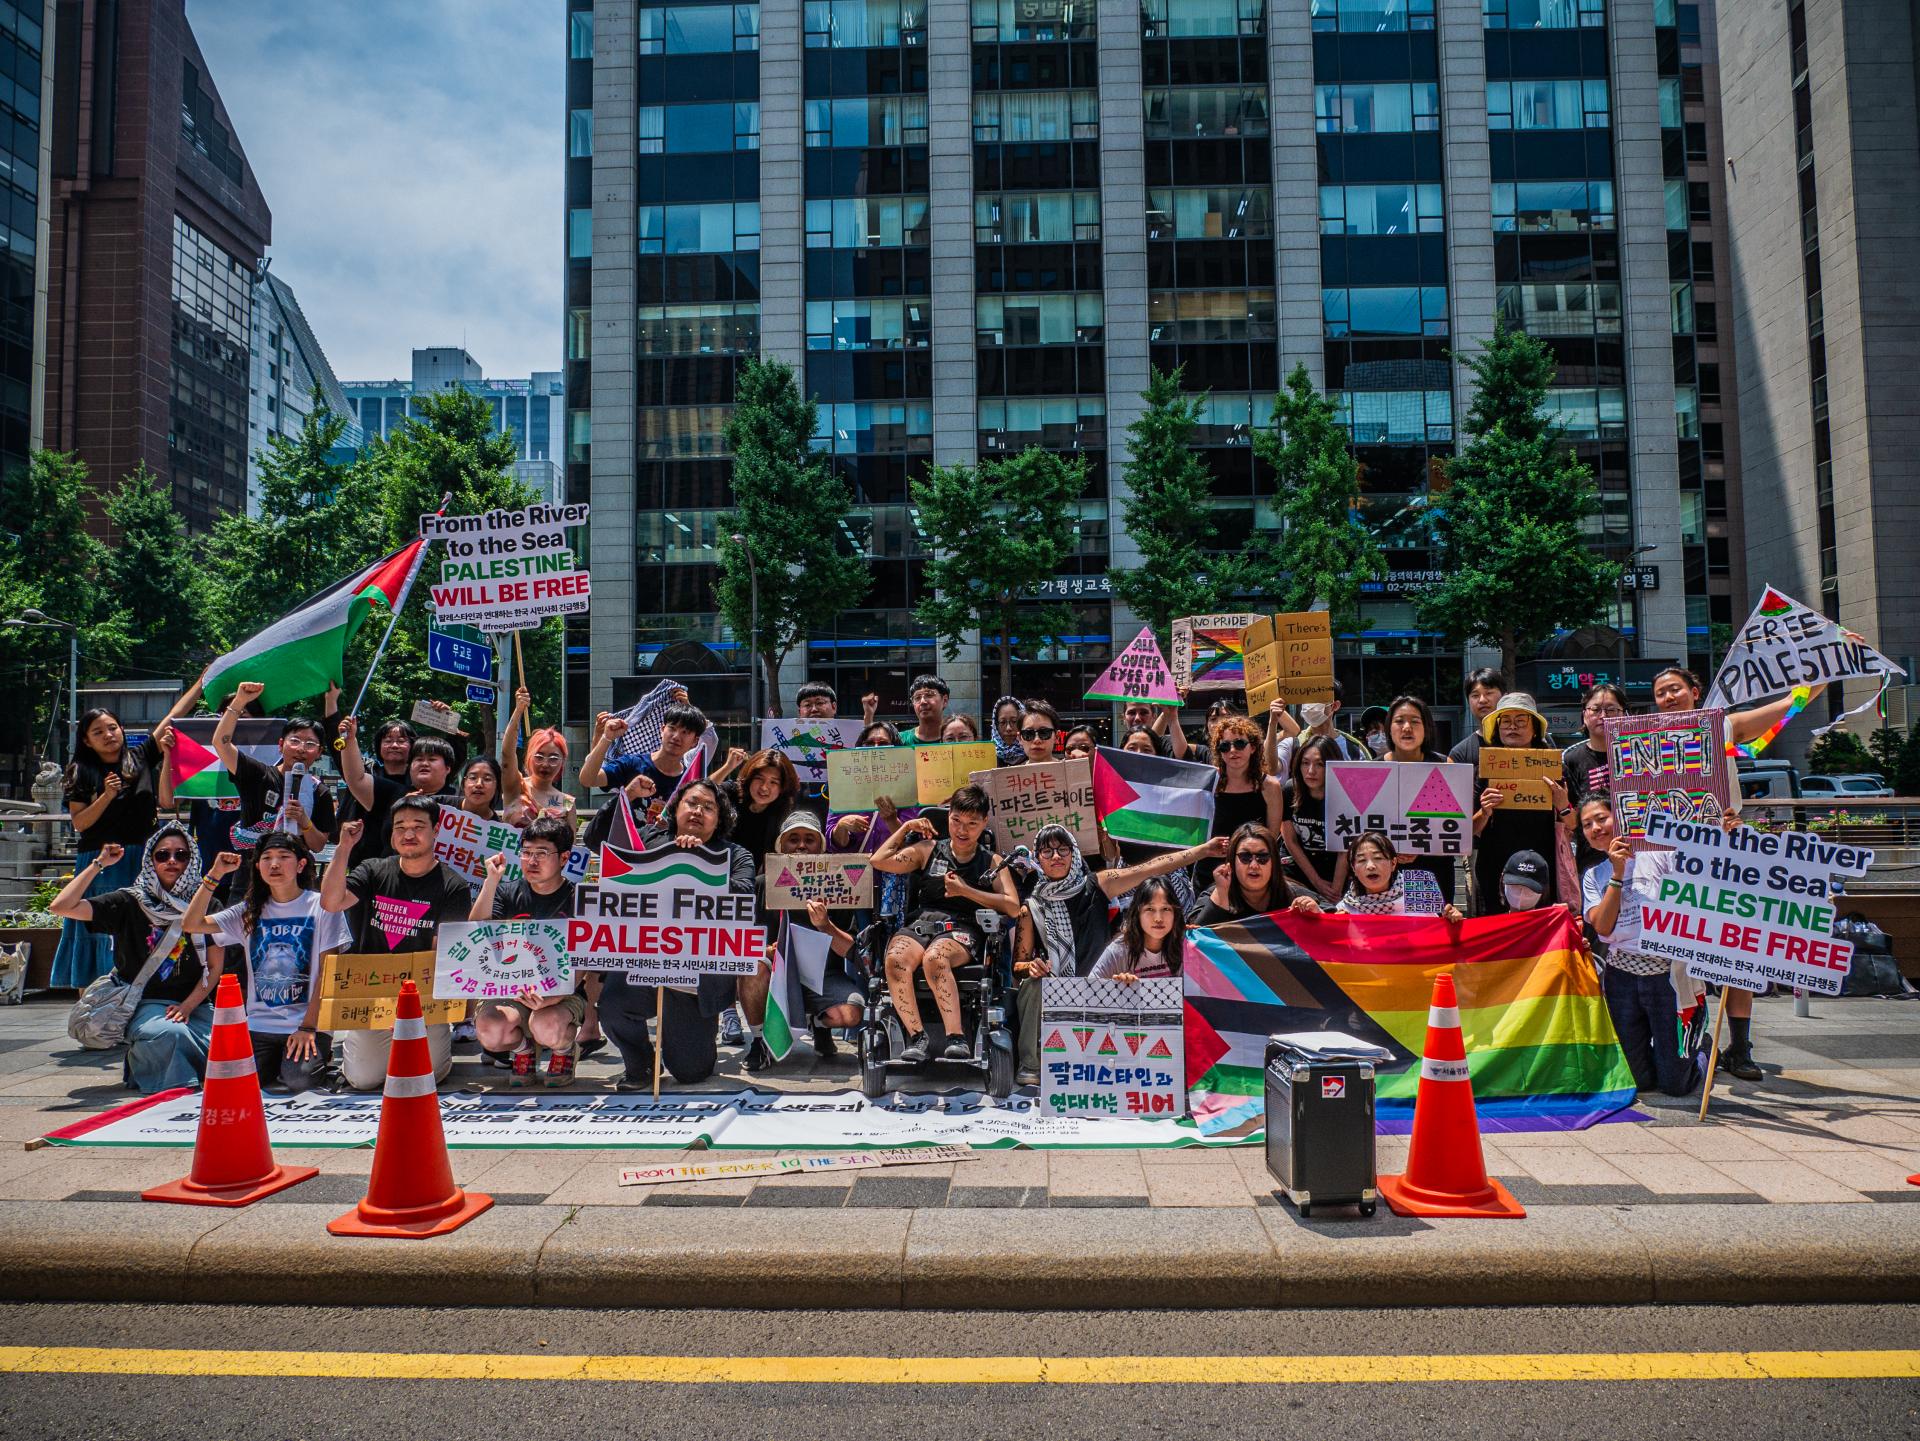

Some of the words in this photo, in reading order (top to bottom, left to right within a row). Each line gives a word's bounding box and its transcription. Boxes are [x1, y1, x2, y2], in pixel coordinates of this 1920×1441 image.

[421, 515, 482, 535] From
[486, 509, 525, 530] the
[530, 504, 588, 526] River
[450, 540, 473, 557] to
[478, 536, 517, 554] the
[521, 532, 564, 549] Sea
[443, 552, 572, 582] PALESTINE
[433, 586, 494, 607] WILL
[499, 583, 529, 602] BE
[534, 574, 590, 599] FREE
[438, 609, 483, 623] 팔레스타인과
[483, 607, 514, 620] 연대하는
[514, 606, 529, 618] 한국
[529, 603, 558, 616] 시민사회
[558, 600, 587, 613] 긴급행동
[1194, 618, 1209, 626] NO
[1213, 616, 1248, 626] PRIDE
[482, 619, 538, 631] #freepalestine
[1285, 622, 1327, 634] There's
[1745, 612, 1823, 654] FREE
[1132, 639, 1154, 653] ALL
[1121, 654, 1160, 670] QUEER
[1292, 655, 1327, 668] Pride
[1717, 641, 1881, 705] PALESTINE
[1109, 667, 1143, 683] EYES
[1146, 671, 1165, 688] ON
[1123, 683, 1150, 697] YOU
[1488, 754, 1519, 770] 우리는
[1006, 772, 1056, 792] 퀴어는
[1513, 793, 1547, 803] exist
[437, 808, 483, 843] 어는
[1648, 814, 1721, 847] From
[1728, 828, 1779, 856] the
[1785, 836, 1872, 871] River
[796, 861, 830, 875] 우리의
[1674, 850, 1703, 875] to
[1711, 857, 1760, 886] the
[1767, 865, 1826, 898] Sea
[576, 885, 659, 918] FREE
[672, 887, 754, 921] FREE
[1659, 878, 1833, 934] PALESTINE
[567, 920, 765, 958] PALESTINE
[1642, 906, 1714, 945] WILL
[1719, 922, 1762, 953] BE
[1766, 932, 1851, 972] FREE
[570, 956, 624, 969] 팔레스타인과
[625, 958, 661, 970] 연대하는
[662, 959, 680, 970] 한국
[682, 959, 718, 972] 시민사회
[719, 961, 755, 972] 긴급행동
[1640, 938, 1695, 960] 팔레스타인과
[1695, 950, 1733, 968] 연대하는
[1734, 959, 1754, 973] 한국
[1755, 963, 1796, 983] 시민사회
[1797, 972, 1839, 992] 긴급행동
[628, 974, 697, 985] #freepalestine
[1690, 965, 1763, 991] #freepalestine
[1048, 1061, 1173, 1087] 팔레스타인과
[1050, 1092, 1118, 1114] 연대하는
[1125, 1091, 1175, 1114] 퀴어
[590, 1113, 707, 1124] 연대한다
[514, 1128, 622, 1136] Palestinian
[625, 1128, 693, 1136] People
[623, 1168, 675, 1181] FROM
[680, 1166, 712, 1177] THE
[718, 1161, 774, 1174] RIVER
[806, 1156, 836, 1168] THE
[839, 1154, 875, 1166] SEA
